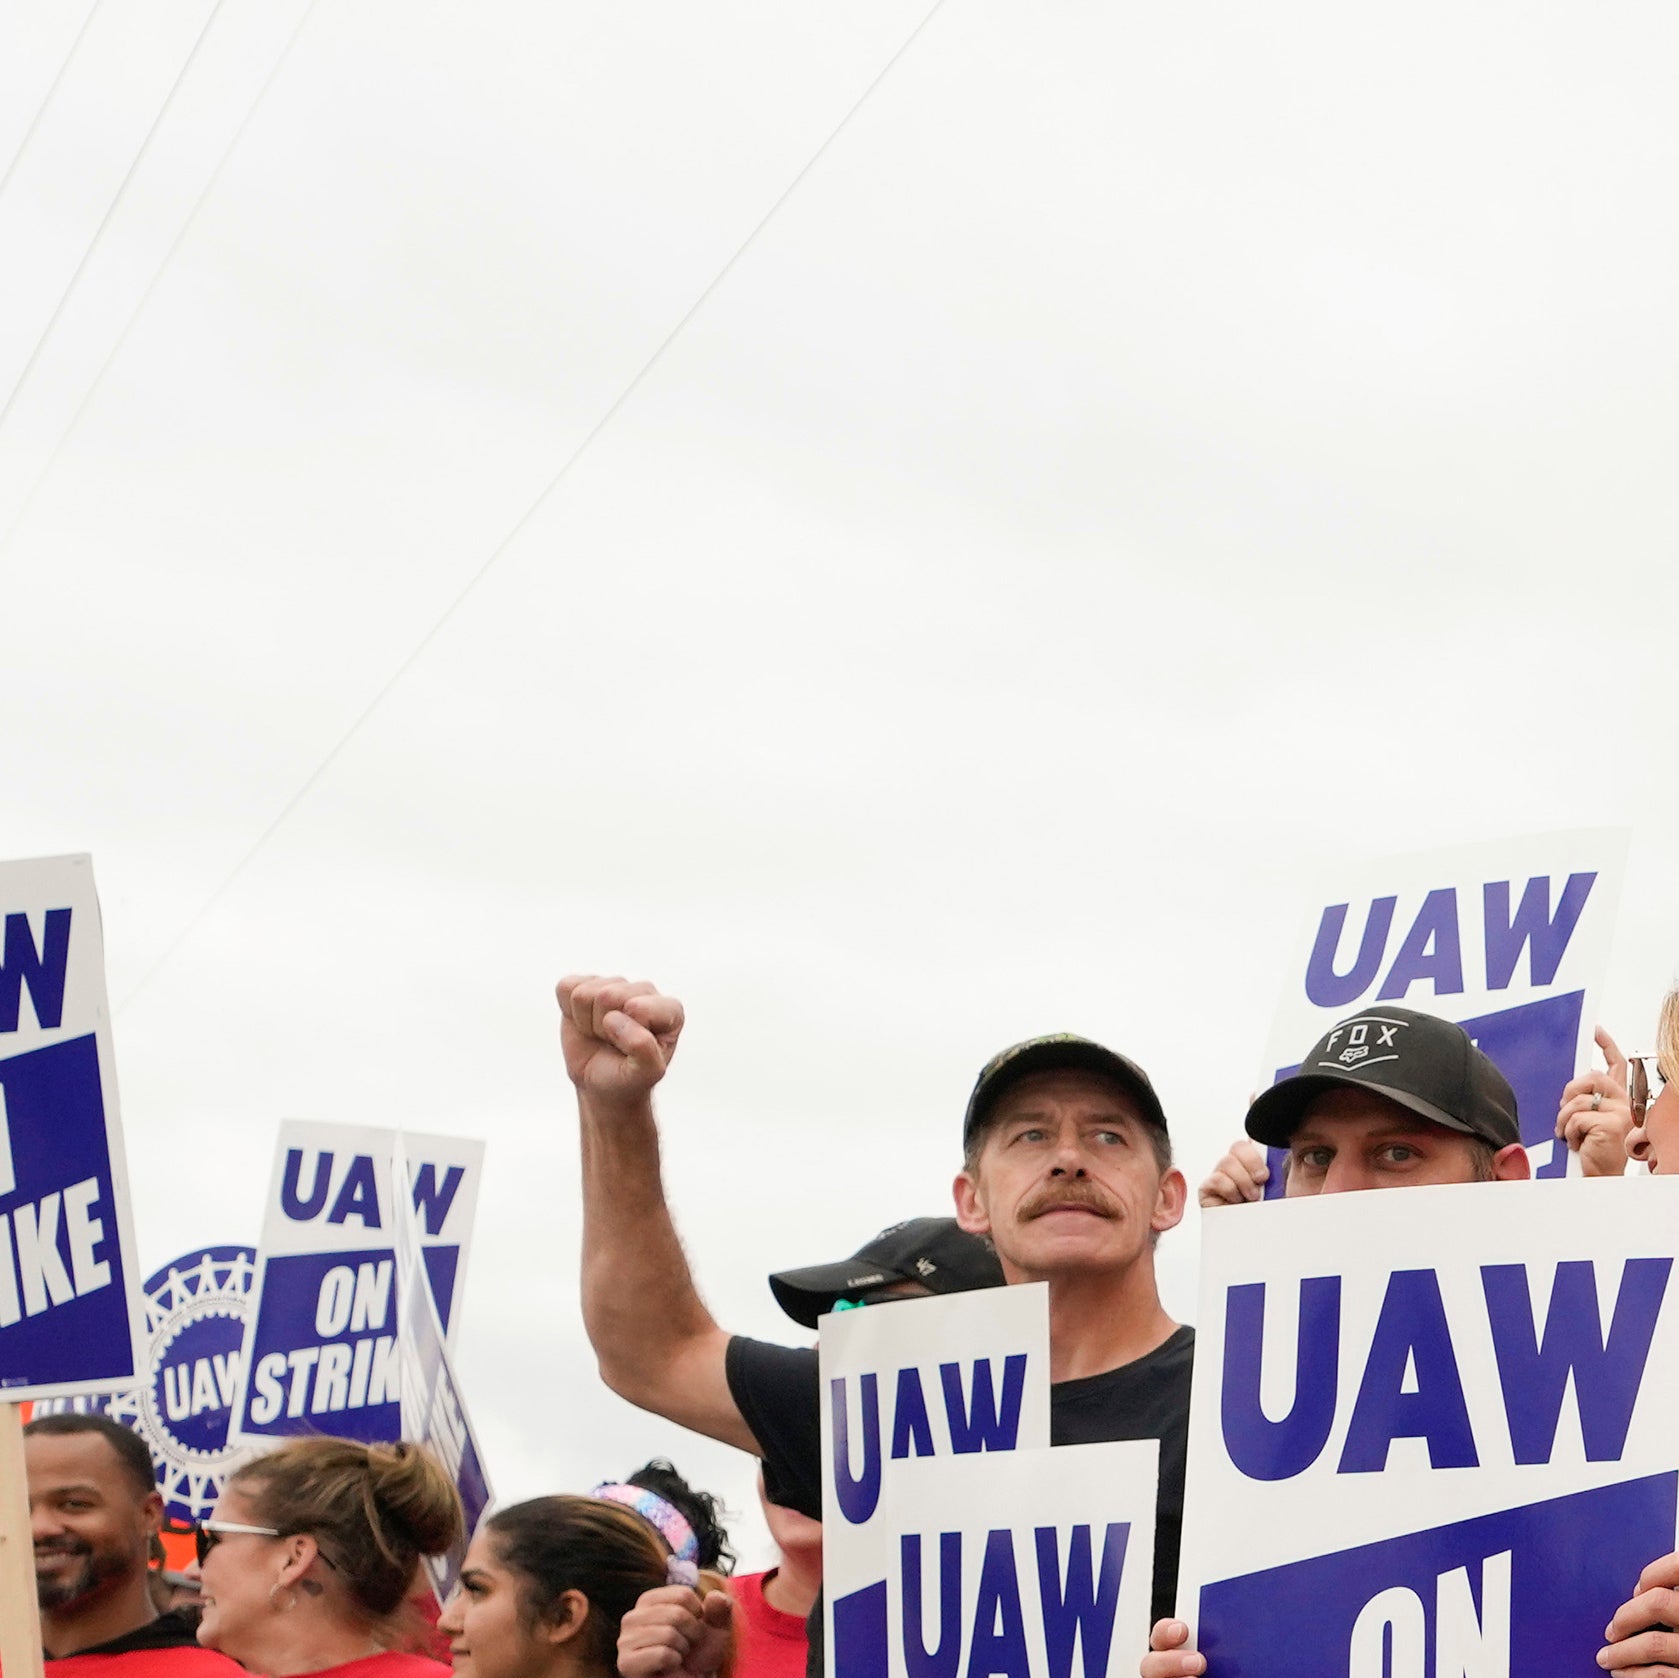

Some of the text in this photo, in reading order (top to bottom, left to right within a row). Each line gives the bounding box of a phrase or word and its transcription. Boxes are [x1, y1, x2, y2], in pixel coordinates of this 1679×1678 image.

[1305, 871, 1599, 1008] UAW
[1325, 1024, 1399, 1053] FOX
[0, 1176, 112, 1328] IKE
[315, 1258, 394, 1339] ON
[250, 1333, 401, 1426] STRIK
[1220, 1256, 1675, 1482] UAW
